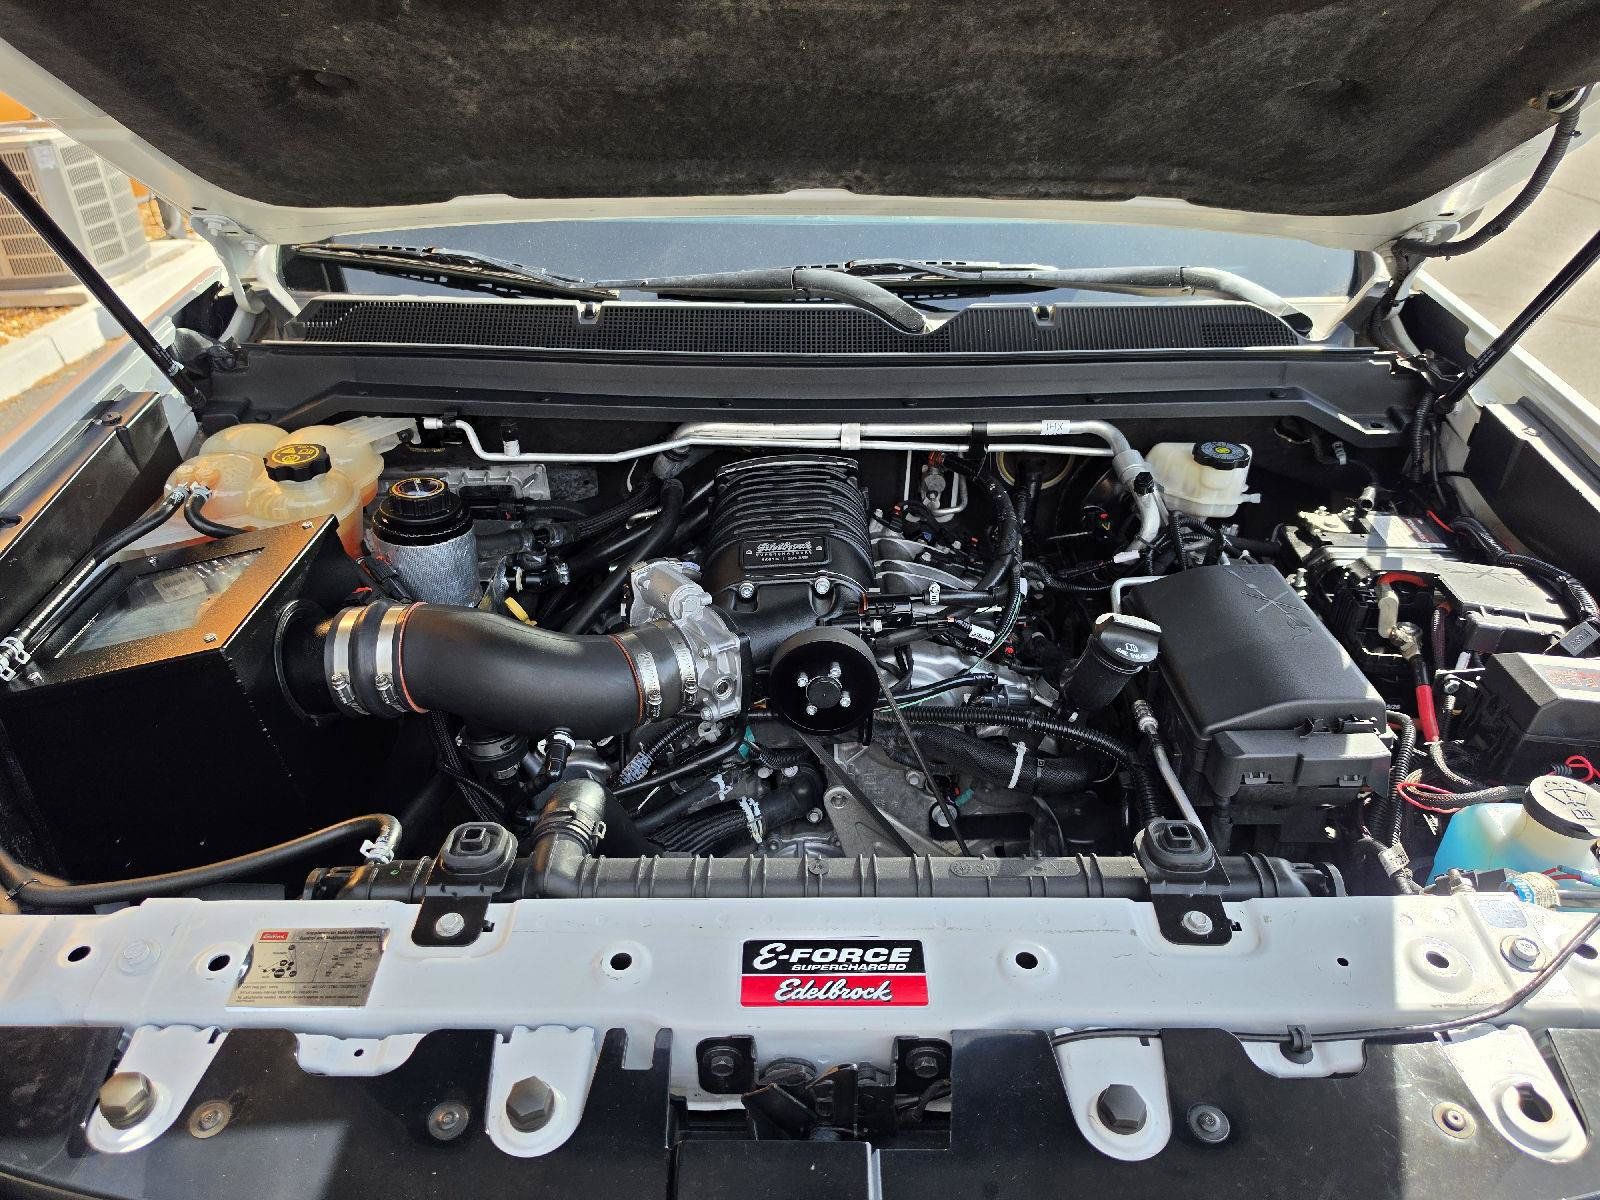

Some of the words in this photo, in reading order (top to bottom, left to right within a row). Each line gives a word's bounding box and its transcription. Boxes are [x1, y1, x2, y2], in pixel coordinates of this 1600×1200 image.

[752, 942, 913, 971] E-FORCE
[791, 963, 907, 971] SUPERCHARGED
[774, 978, 893, 1002] Edelbrock
